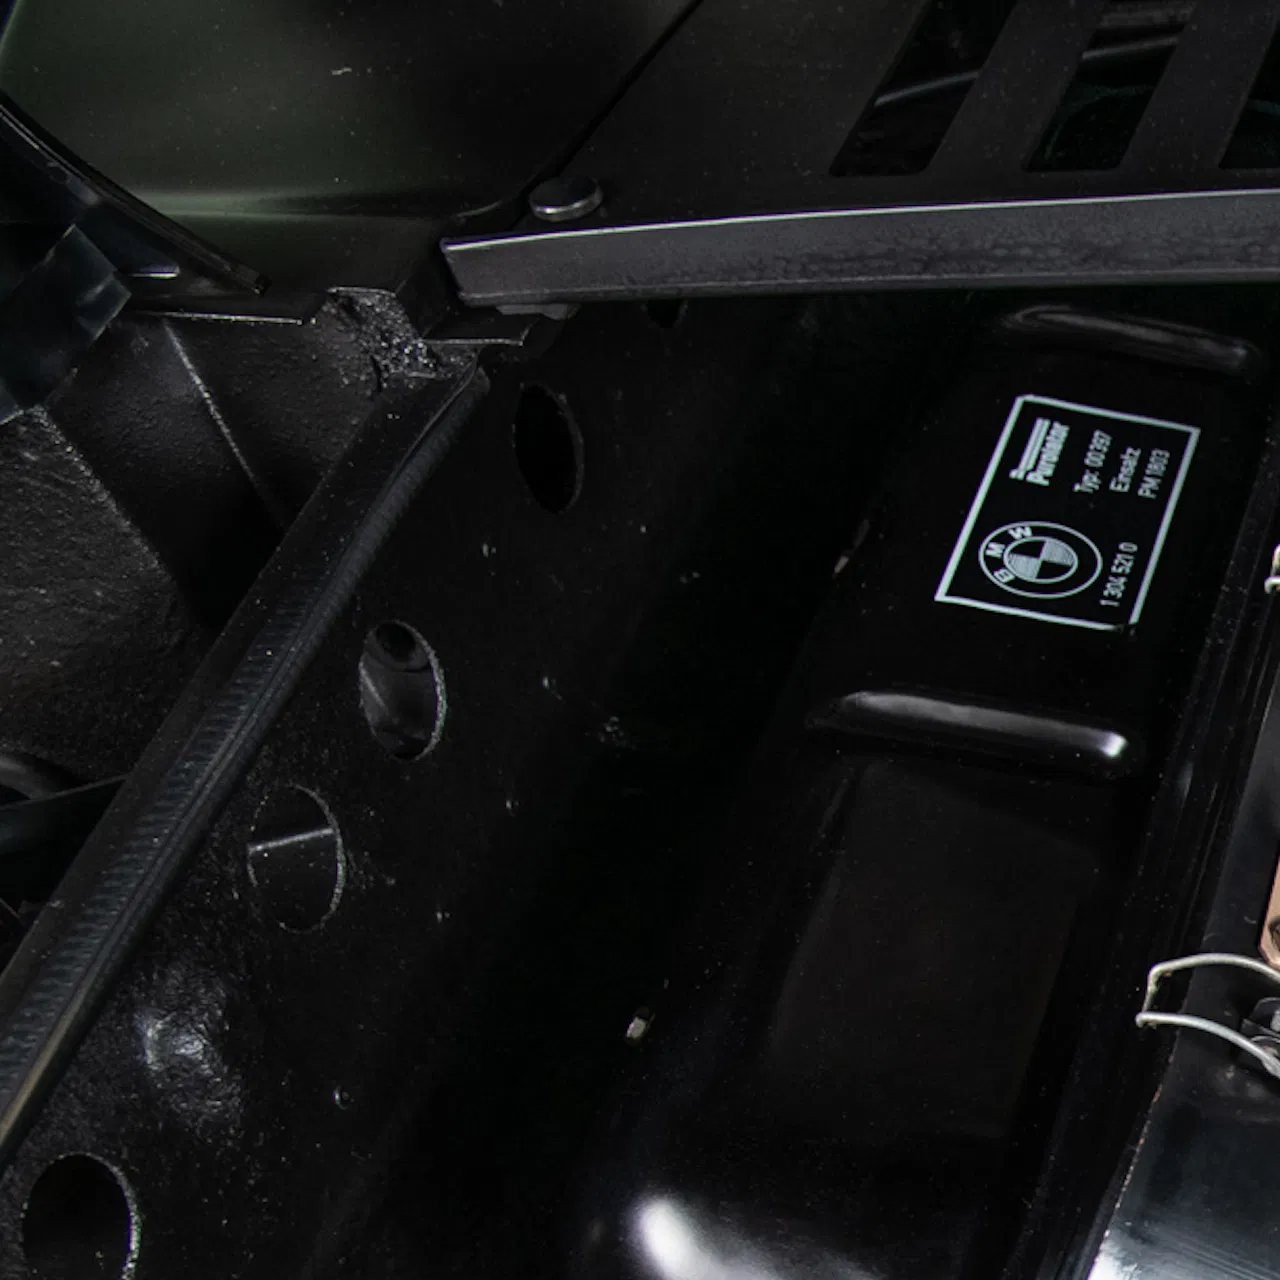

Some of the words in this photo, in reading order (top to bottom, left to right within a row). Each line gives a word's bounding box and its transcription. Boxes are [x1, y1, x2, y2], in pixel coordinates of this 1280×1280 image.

[1109, 446, 1141, 492] Einsatz
[1138, 475, 1161, 499] PM
[985, 526, 1032, 583] BMW
